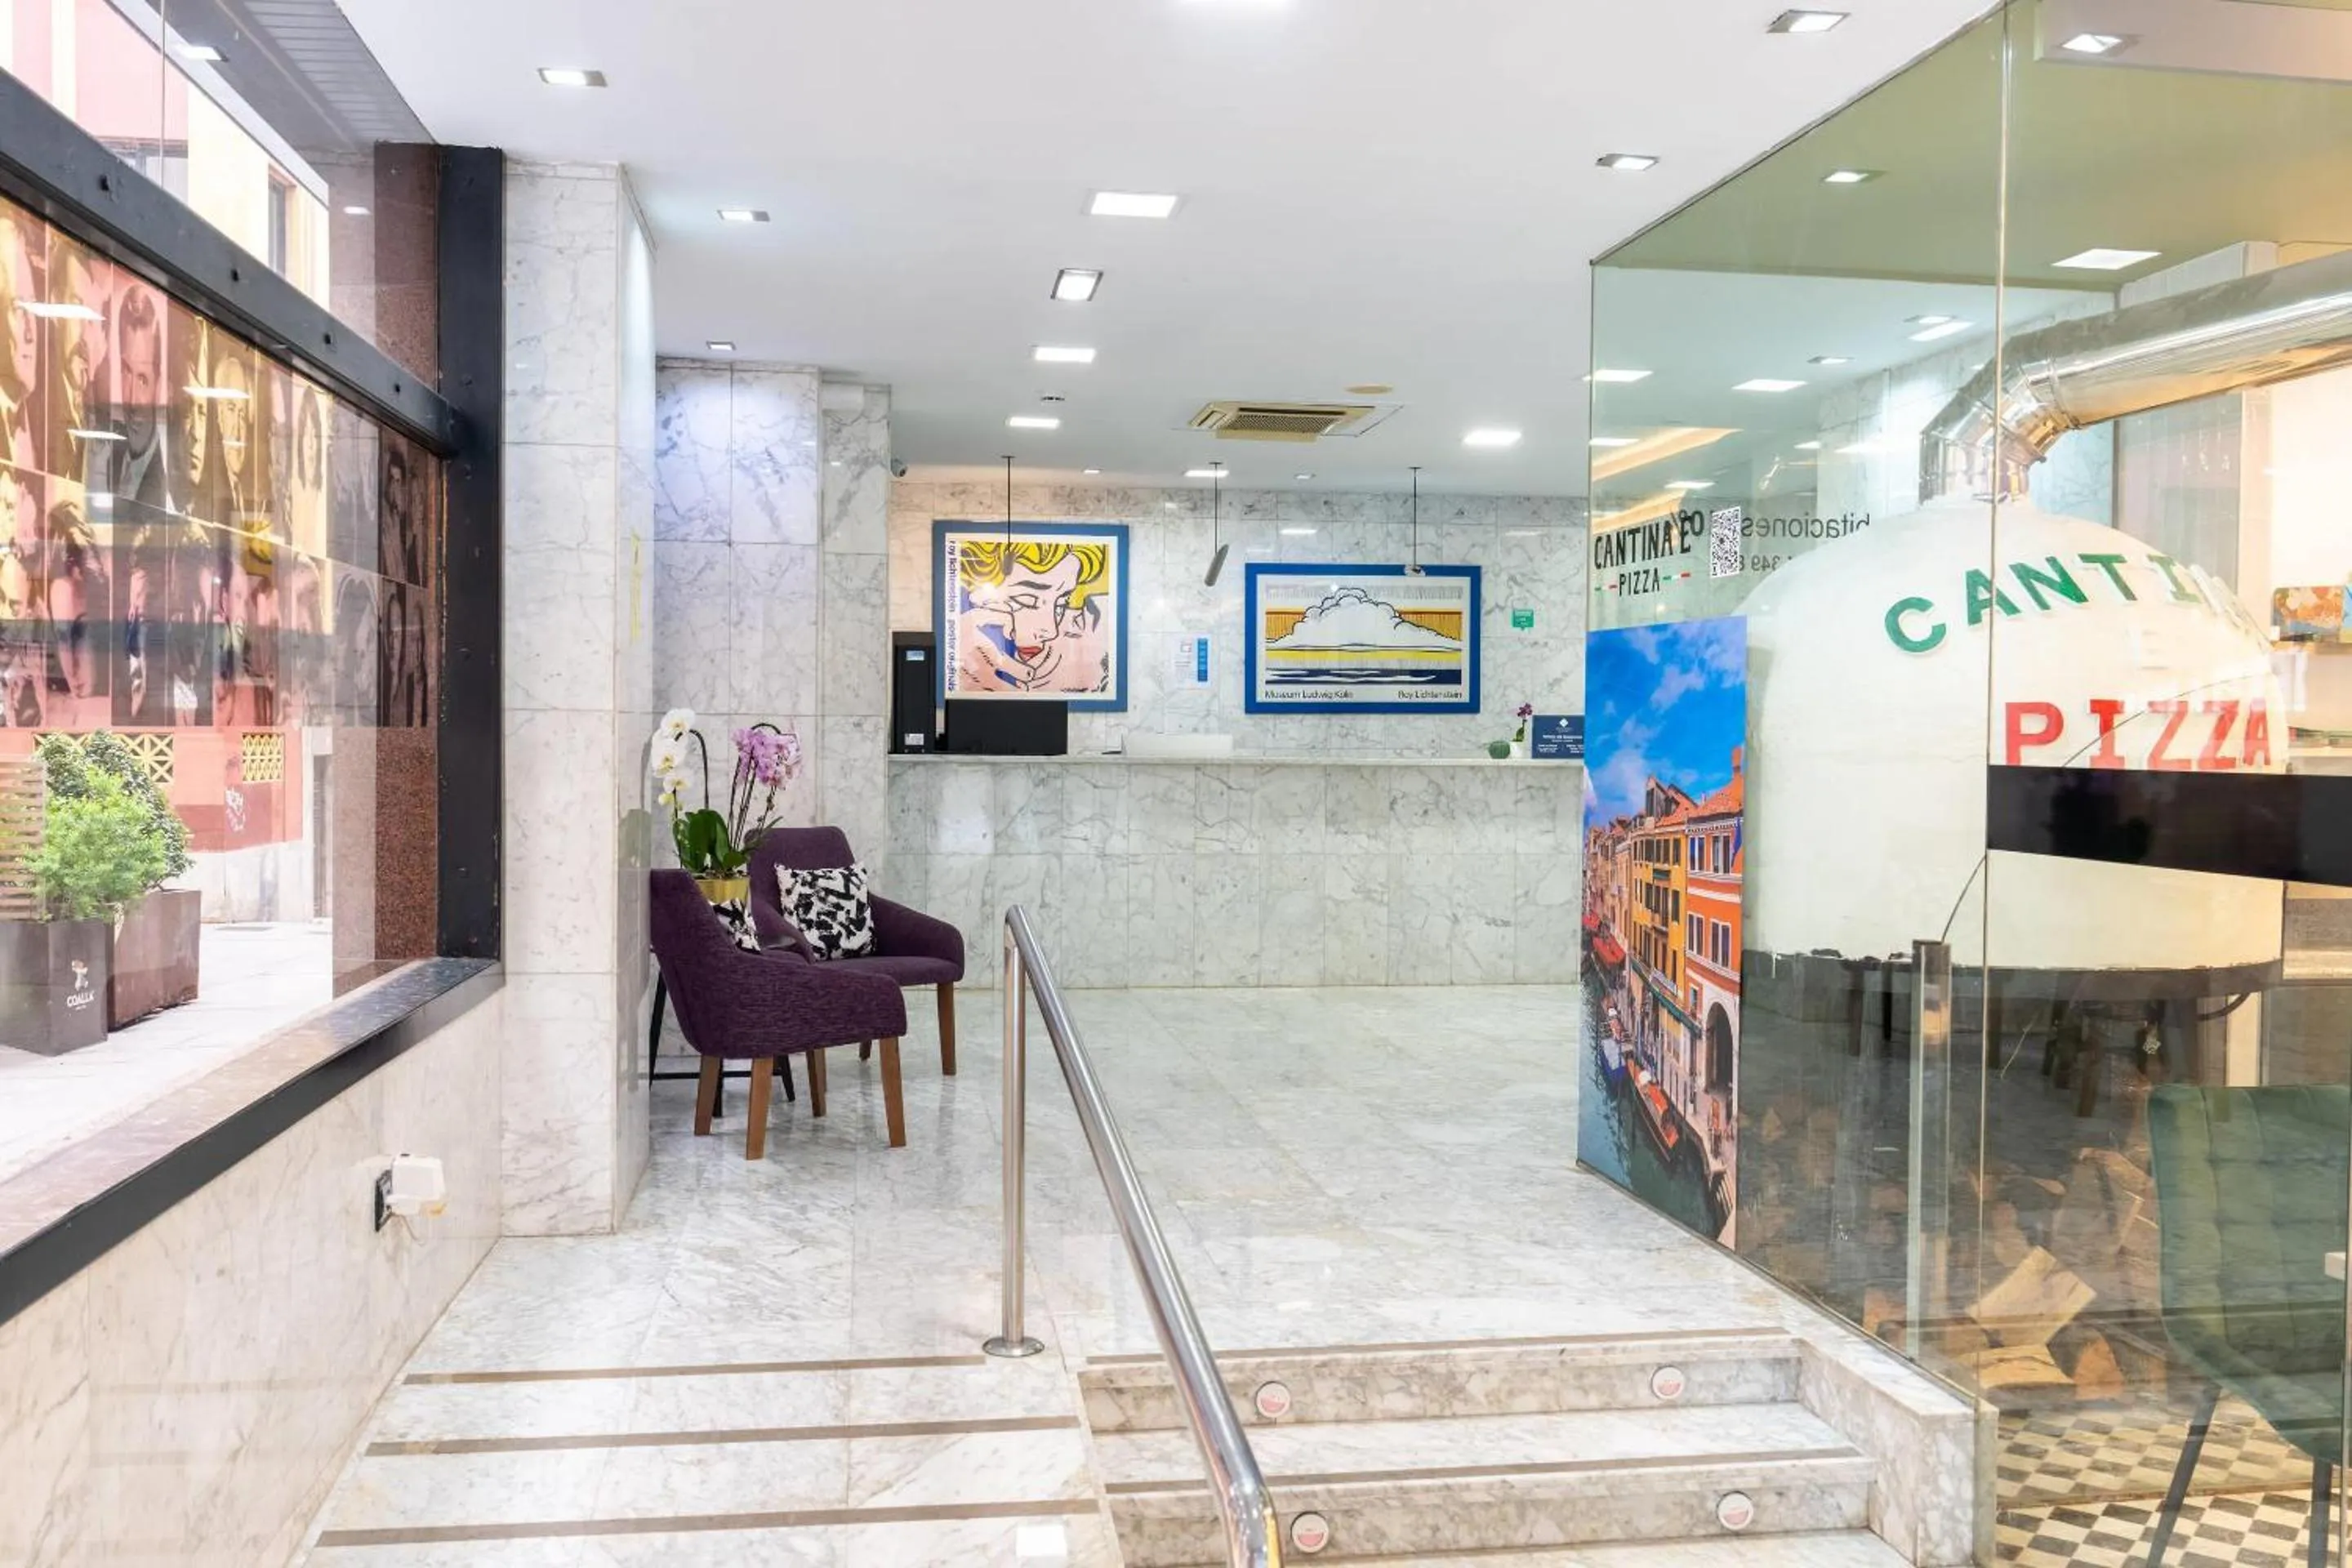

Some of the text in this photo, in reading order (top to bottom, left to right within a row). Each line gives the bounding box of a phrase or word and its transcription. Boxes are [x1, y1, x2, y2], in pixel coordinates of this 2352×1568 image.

[1594, 520, 1673, 570] CANTINA
[1619, 567, 1660, 597] PIZZA
[1884, 553, 2256, 653] CANTI
[1264, 689, 1301, 699] Museum
[1397, 689, 1414, 700] Roy
[2004, 697, 2272, 770] PIZZA
